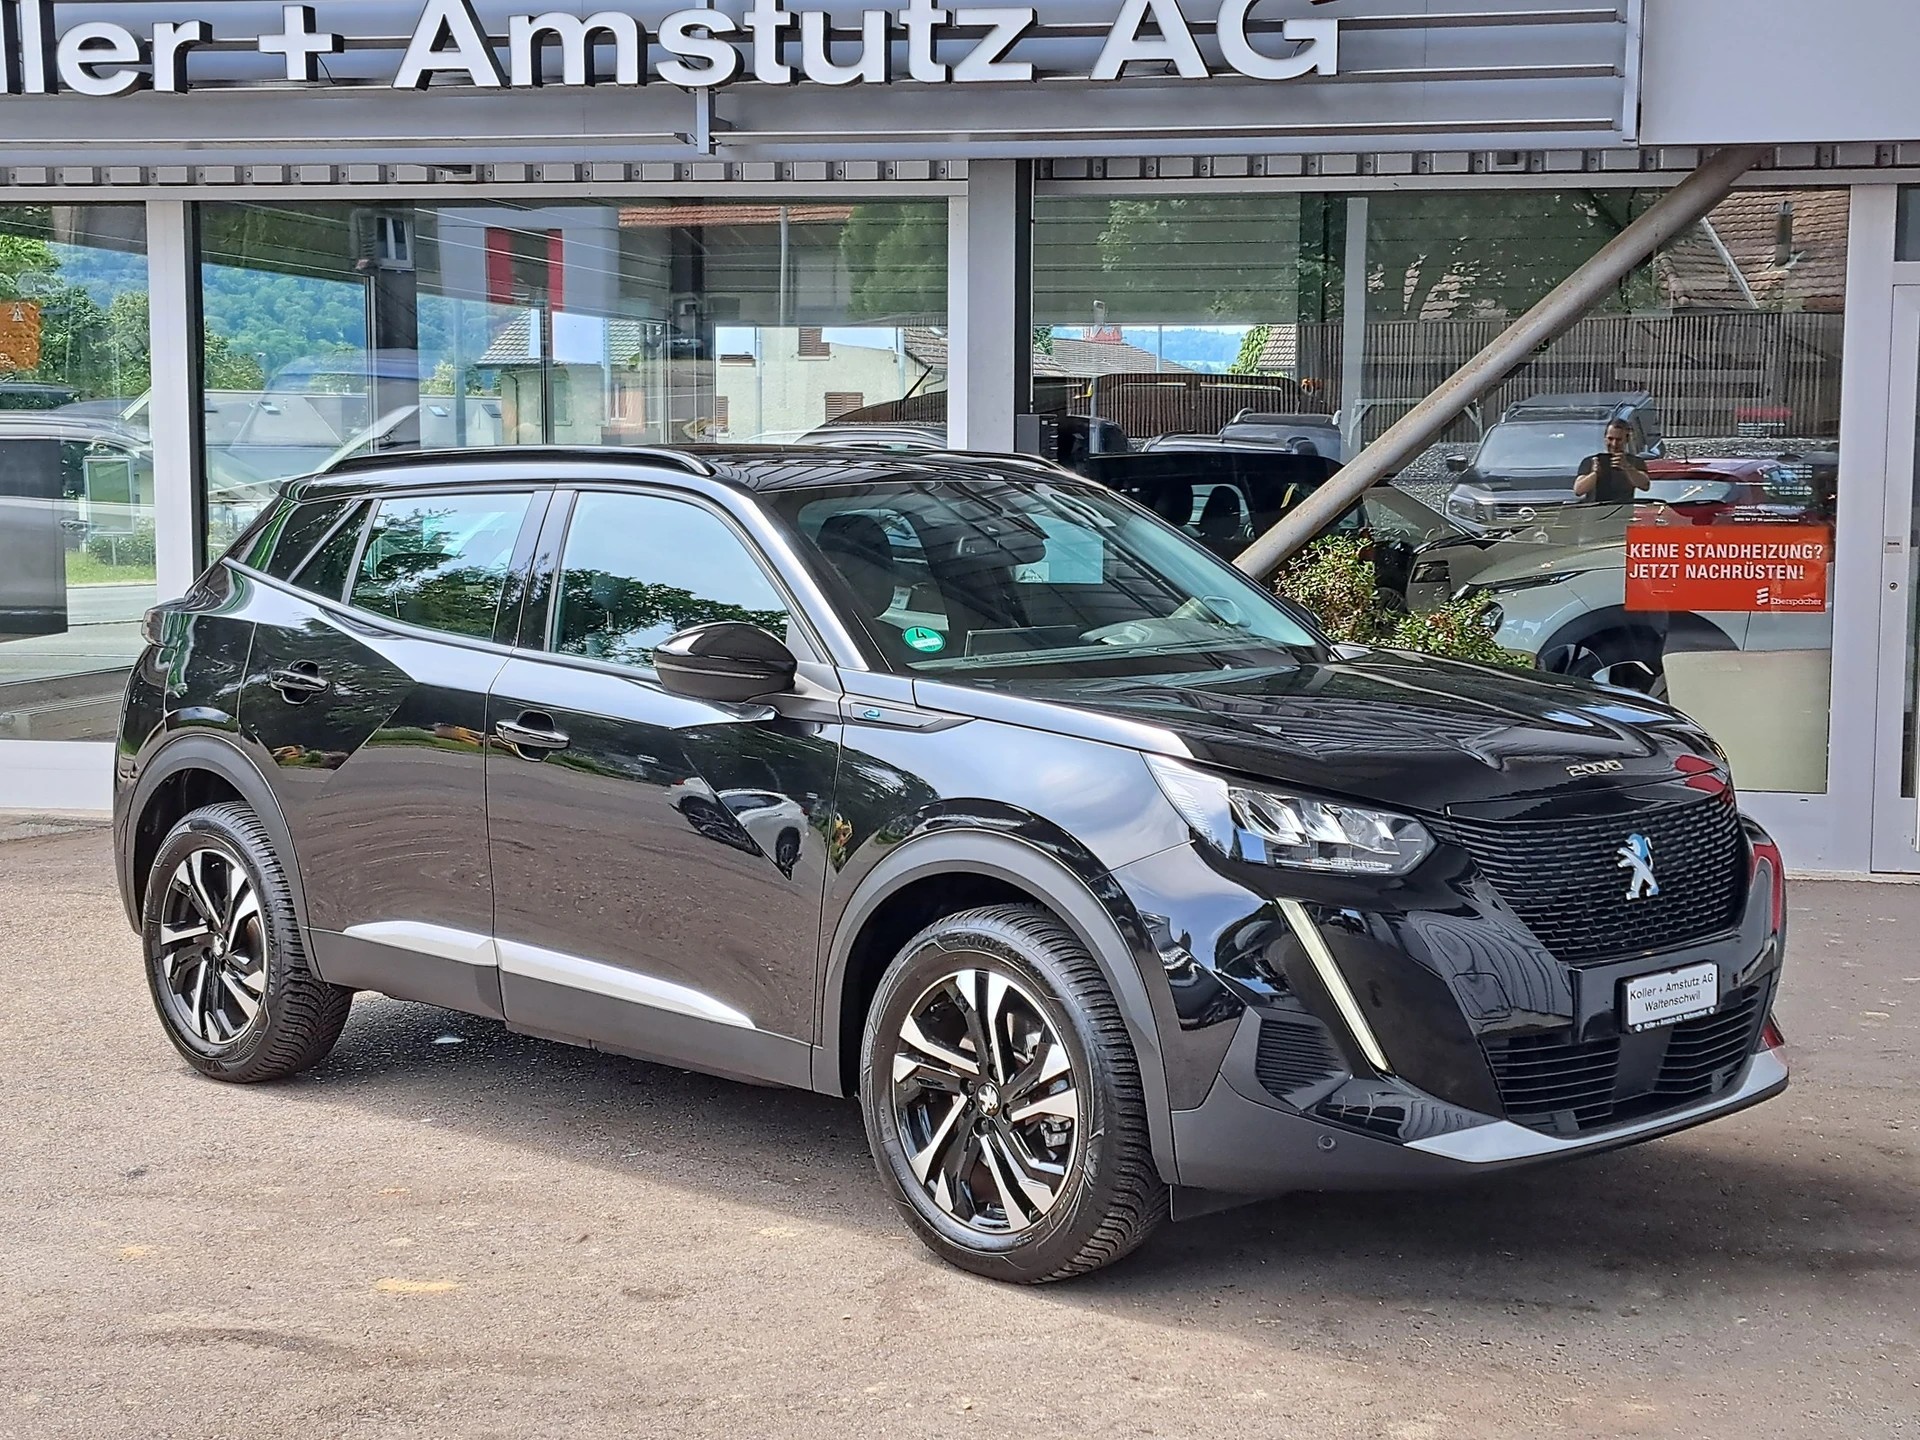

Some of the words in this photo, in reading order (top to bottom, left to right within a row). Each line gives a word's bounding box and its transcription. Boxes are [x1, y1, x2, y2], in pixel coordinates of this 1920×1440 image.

[393, 0, 1037, 88] Amstutz
[1088, 0, 1340, 81] AG
[1629, 543, 1679, 559] KEINE
[1684, 543, 1824, 560] STANDHEIZUNG?
[1628, 563, 1679, 579] JETZT
[1685, 561, 1805, 580] NACHRÜSTEN!
[1566, 759, 1624, 777] 2008
[1629, 986, 1657, 1001] Koller
[1665, 977, 1700, 993] Amstutz
[1701, 972, 1714, 985] AG
[1644, 989, 1702, 1012] Waltenschwil
